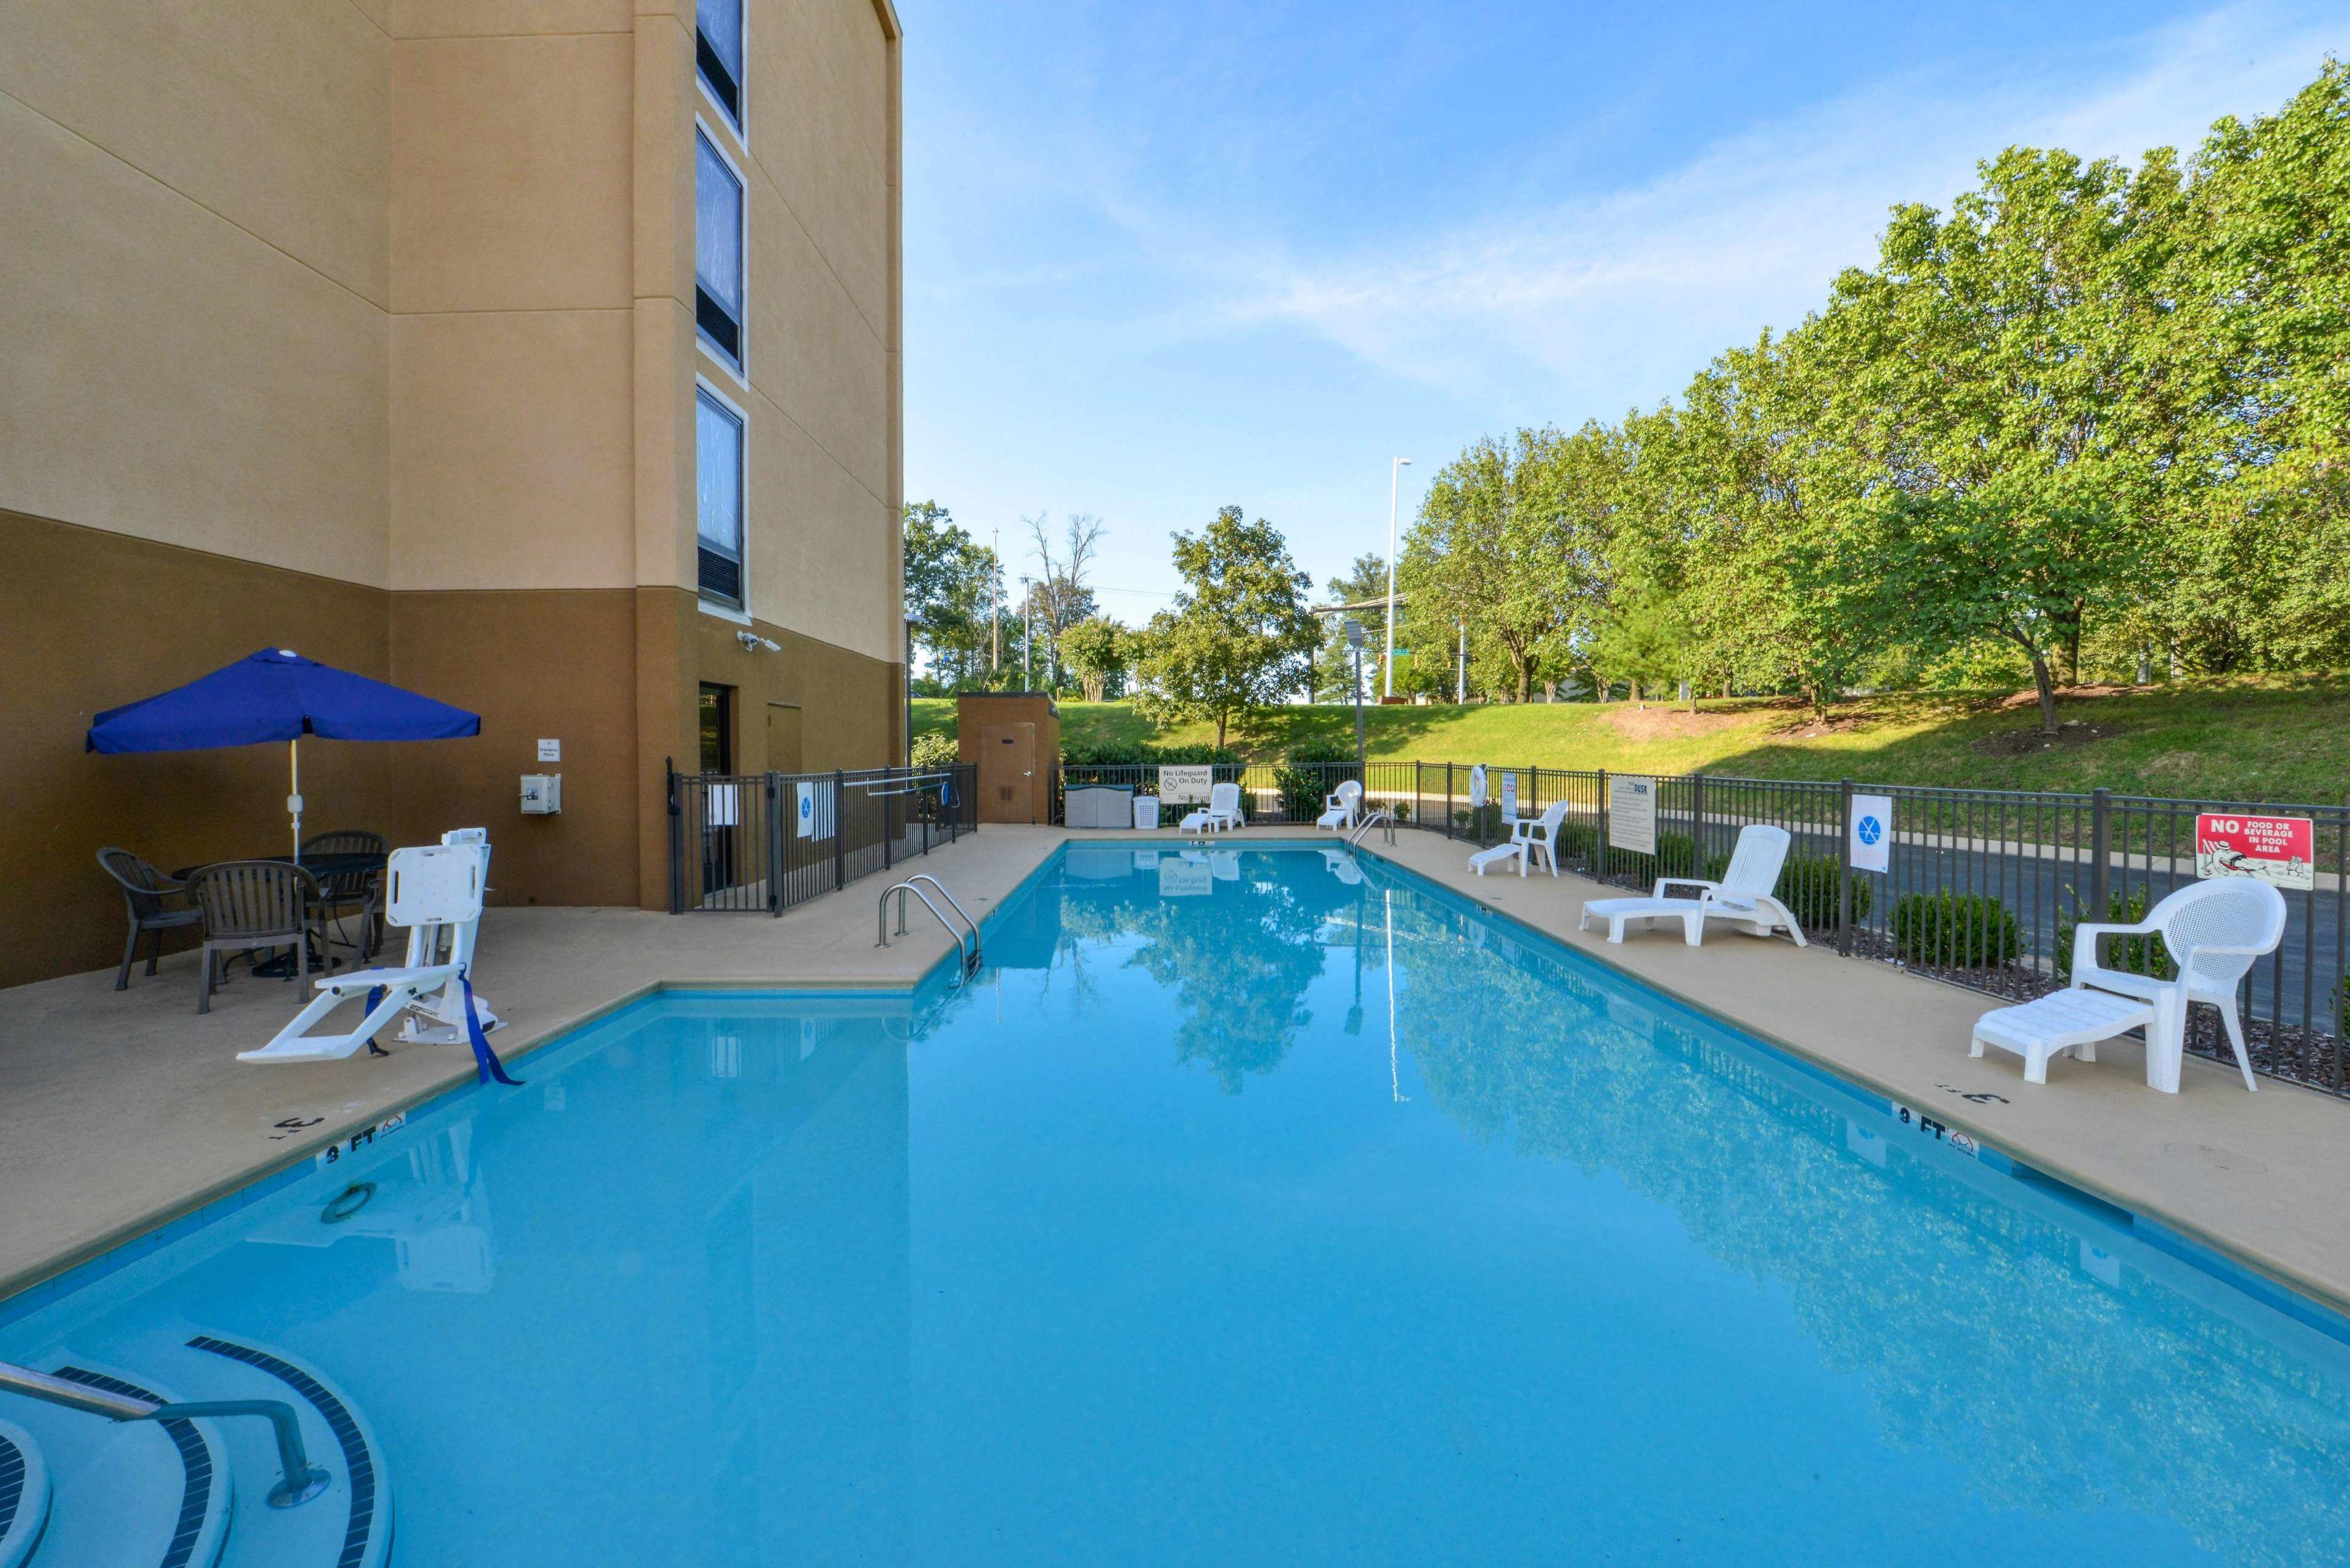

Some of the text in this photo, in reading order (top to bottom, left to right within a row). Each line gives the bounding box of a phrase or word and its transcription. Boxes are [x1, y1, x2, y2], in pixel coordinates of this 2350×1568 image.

[1634, 784, 1647, 793] DUSK
[2211, 820, 2239, 833] NO
[2244, 828, 2293, 837] BEVERAGE
[2262, 837, 2288, 846] POOL
[1962, 1094, 2010, 1104] 3
[274, 1117, 325, 1127] 3
[1920, 1115, 1946, 1140] FT
[351, 1125, 377, 1153] FT
